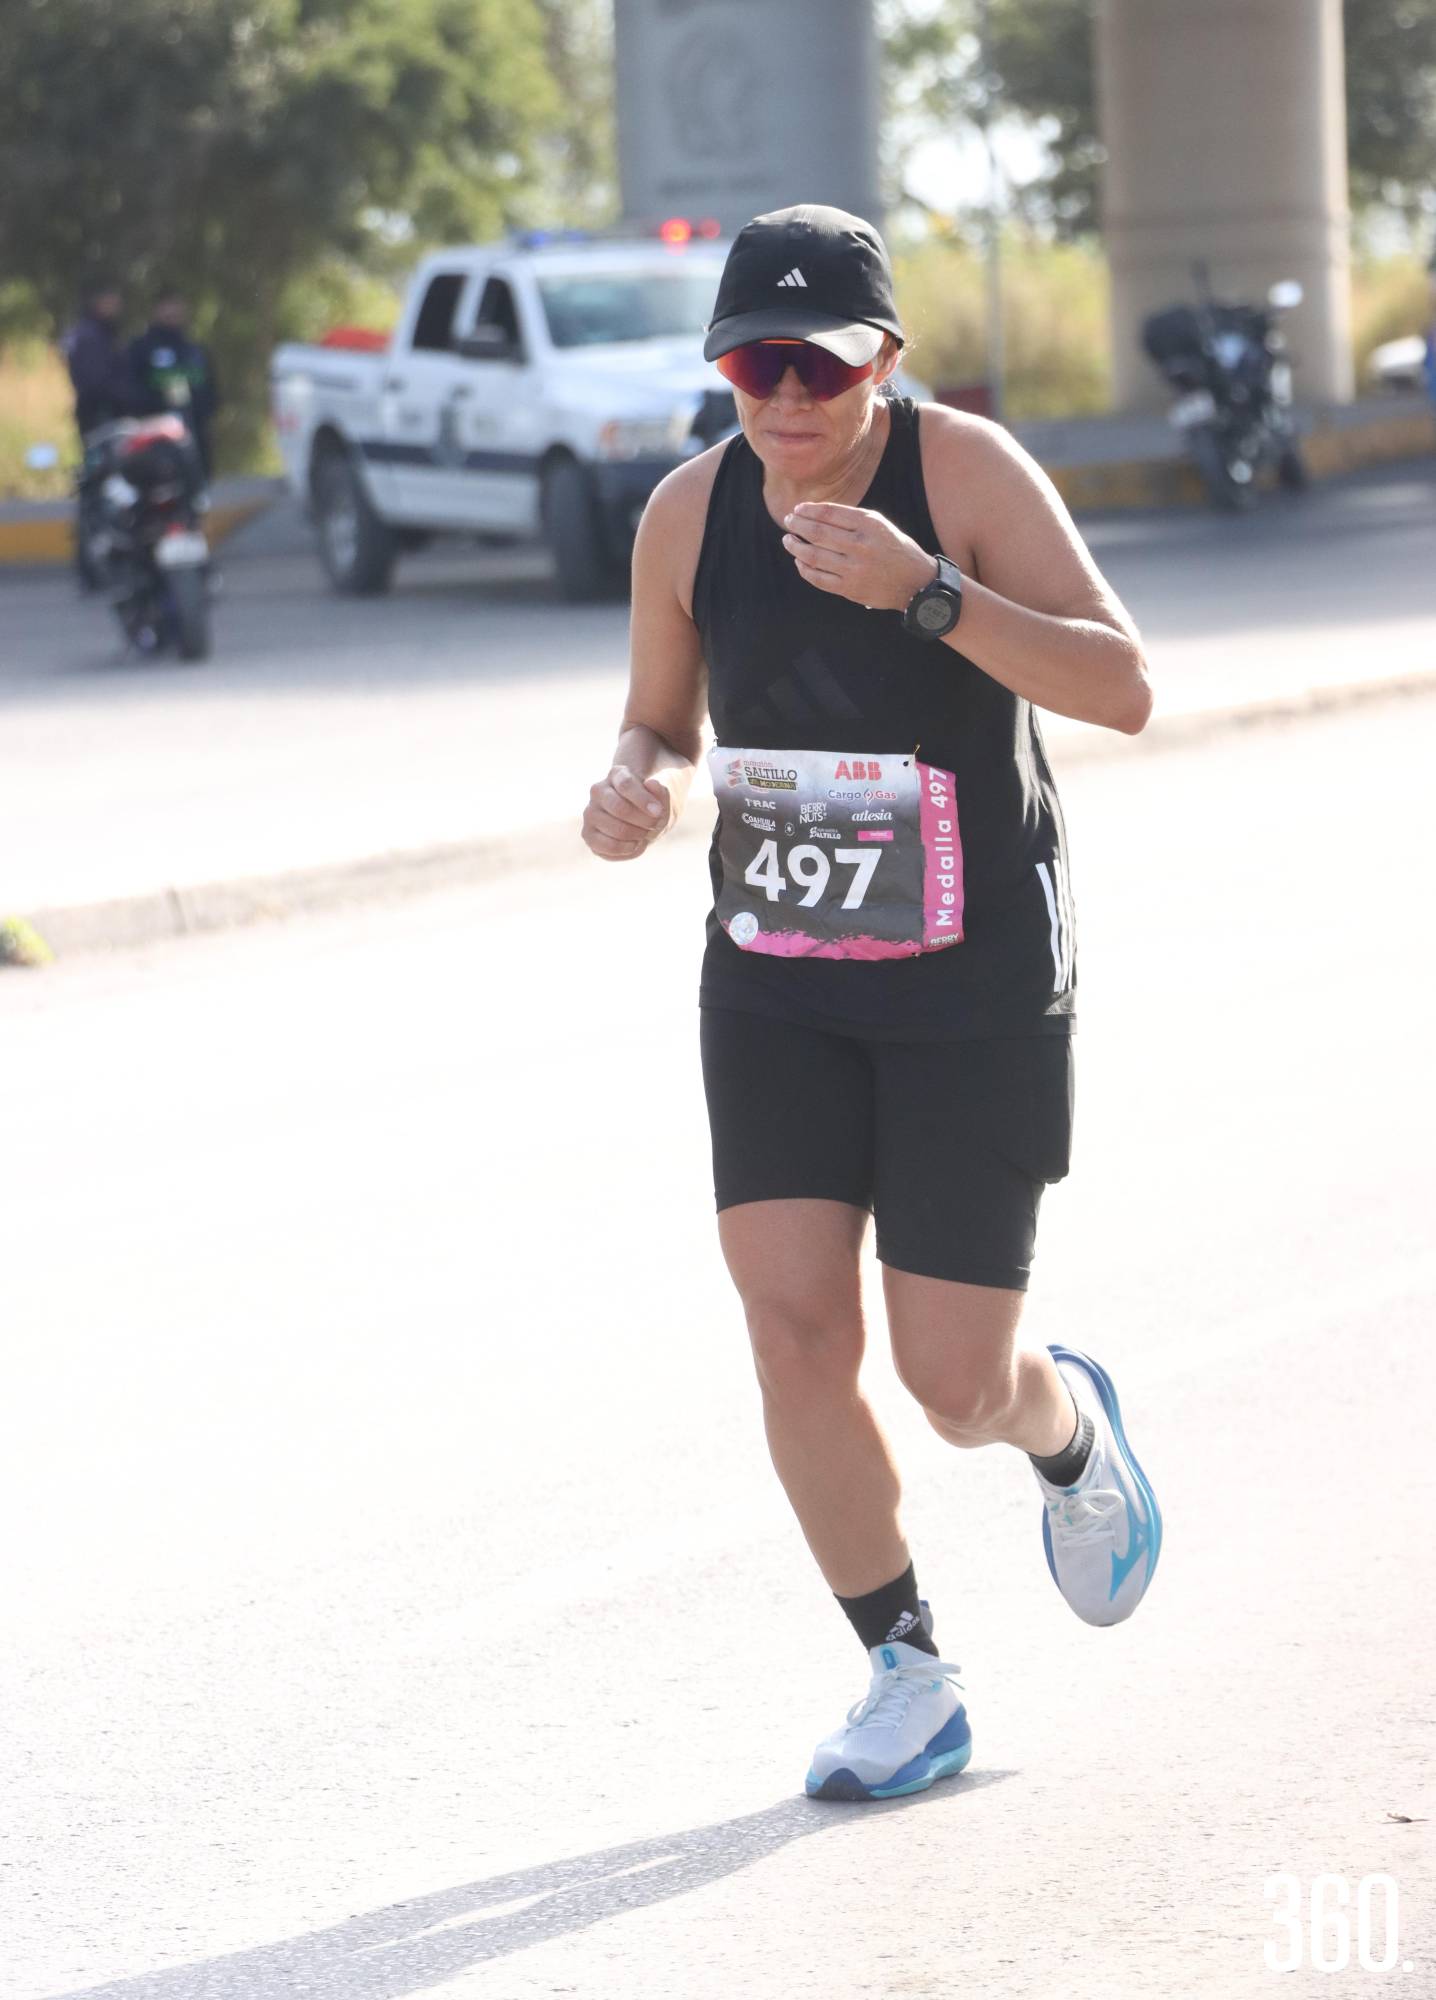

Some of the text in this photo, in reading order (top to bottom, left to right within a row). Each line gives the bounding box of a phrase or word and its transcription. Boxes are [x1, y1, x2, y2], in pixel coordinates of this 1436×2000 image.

[744, 767, 798, 781] SALTILLO
[834, 760, 882, 780] ABB
[828, 789, 897, 801] Cargo Gas
[745, 798, 776, 810] TRAC
[800, 802, 828, 815] BERRY
[741, 812, 776, 828] COAHUILA
[851, 809, 893, 822] atlesia
[809, 827, 842, 840] SALTILLO
[930, 767, 955, 926] Medalla 497
[744, 838, 883, 909] 497
